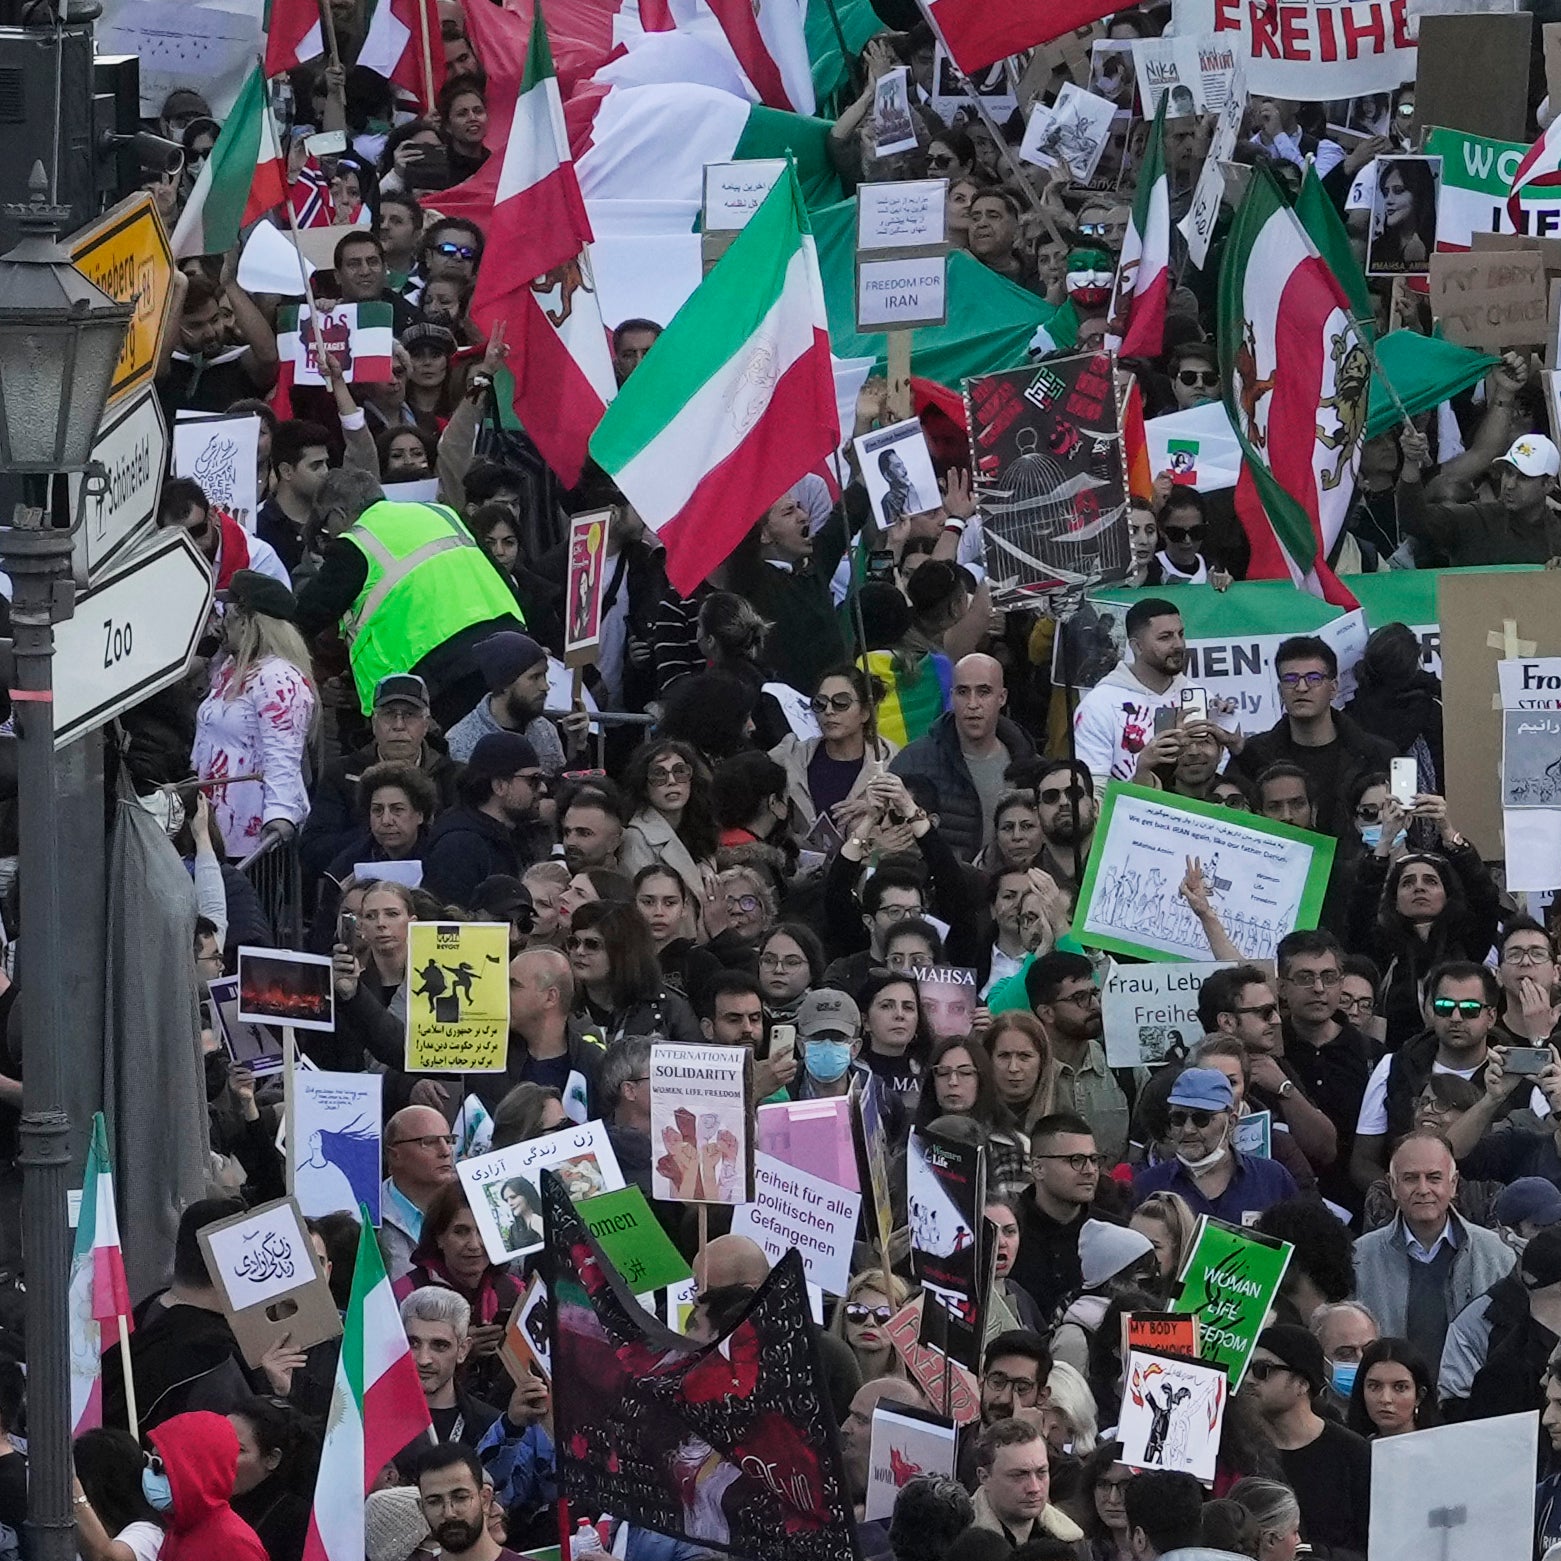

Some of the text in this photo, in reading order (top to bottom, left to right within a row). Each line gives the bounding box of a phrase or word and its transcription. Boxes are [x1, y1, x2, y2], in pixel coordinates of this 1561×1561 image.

[865, 276, 941, 294] FREEDOM FOR
[884, 294, 918, 310] IRAN
[103, 618, 133, 668] Zoo
[913, 967, 976, 986] MAHSA
[1108, 974, 1161, 995] Frau,
[654, 1049, 741, 1064] INTERNATIONAL
[655, 1065, 737, 1081] SOLIDARITY
[652, 1085, 741, 1099] WOMEN, FREEDOM
[470, 1131, 595, 1182] زن زندگی آزادی
[756, 1191, 836, 1234] politischen
[800, 1185, 854, 1219] für alle
[749, 1209, 836, 1257] Gefangenen
[1203, 1266, 1263, 1299] WOMAN
[1206, 1298, 1242, 1321] LIFE
[1130, 1321, 1177, 1335] MY BODY
